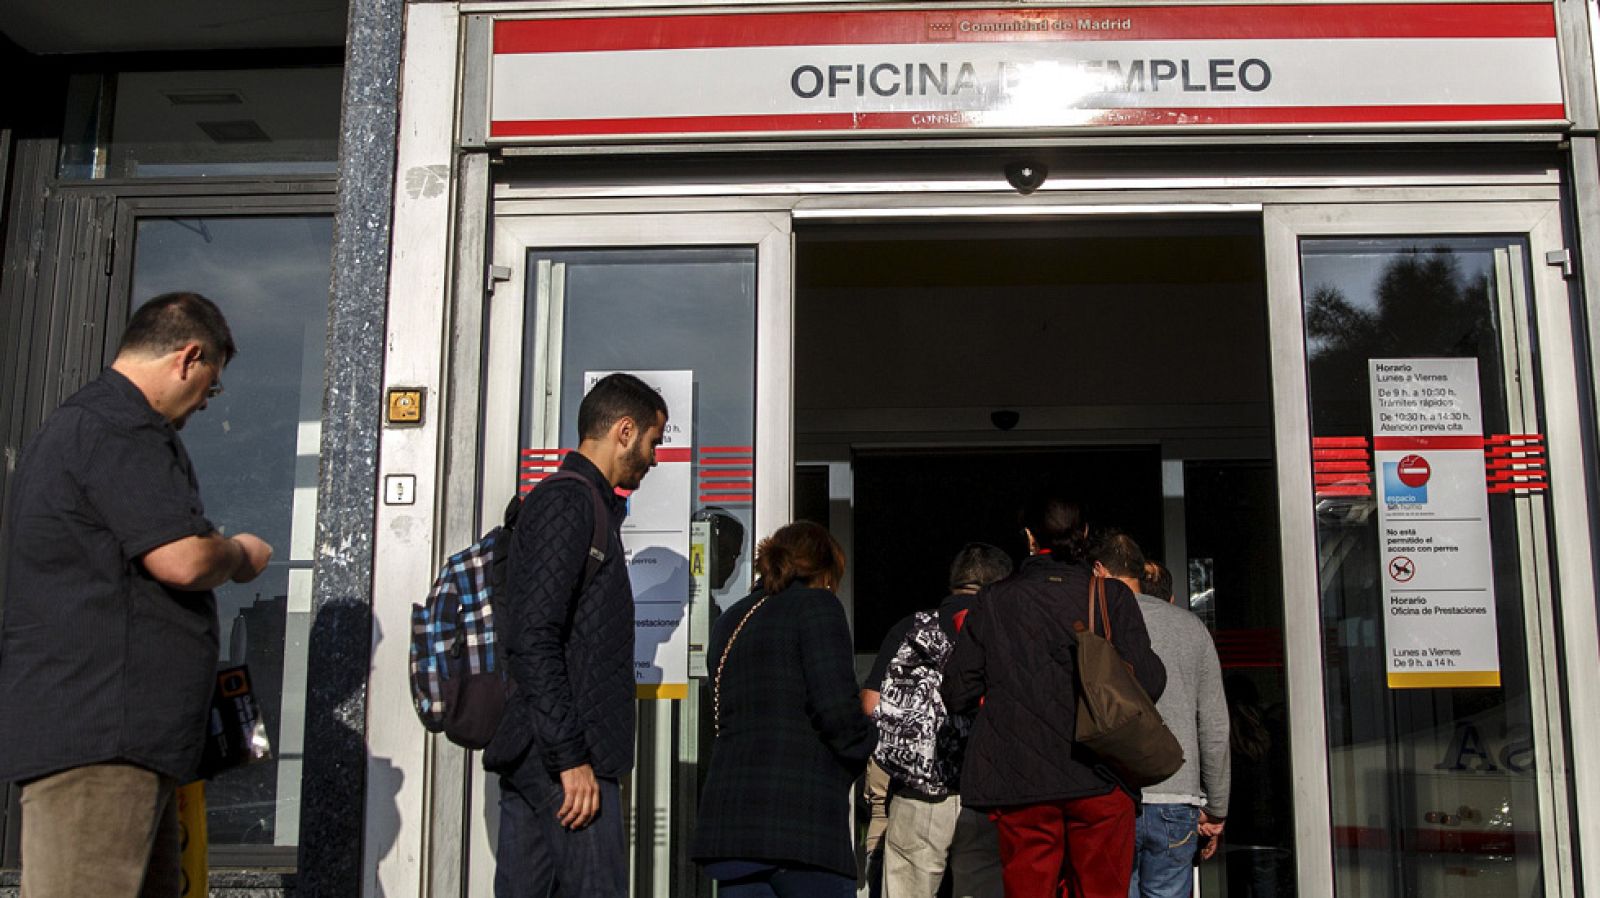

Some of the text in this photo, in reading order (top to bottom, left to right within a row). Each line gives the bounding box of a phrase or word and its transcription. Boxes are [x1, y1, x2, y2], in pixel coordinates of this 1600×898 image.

[959, 18, 1131, 32] Comunidad de Madrid
[790, 62, 983, 99] OFICINA
[1376, 364, 1413, 372] Horario
[1377, 374, 1404, 382] Lunes
[1414, 373, 1448, 381] Viernes
[1378, 388, 1391, 397] De
[1393, 388, 1400, 397] 9
[1402, 388, 1411, 397] h.
[1421, 388, 1446, 397] 10:30
[1448, 387, 1457, 396] h.
[1379, 398, 1454, 408] Trámites rápidos
[1380, 412, 1392, 421] De
[1394, 412, 1418, 421] 10:30
[1438, 412, 1461, 420] 14:30
[1463, 412, 1471, 420] h.
[1380, 423, 1464, 432] Atención previa cita
[1387, 495, 1416, 504] espacio
[1387, 537, 1425, 545] permitido
[632, 558, 657, 566] perros
[1390, 596, 1427, 605] Horario
[1390, 606, 1487, 616] Oficina de Prestaciones
[1393, 648, 1461, 657] Lunes a Viernes
[1393, 659, 1406, 668] De
[1407, 659, 1414, 667] 9
[1415, 659, 1425, 667] h.
[1434, 658, 1445, 667] 14
[1447, 658, 1456, 667] h.
